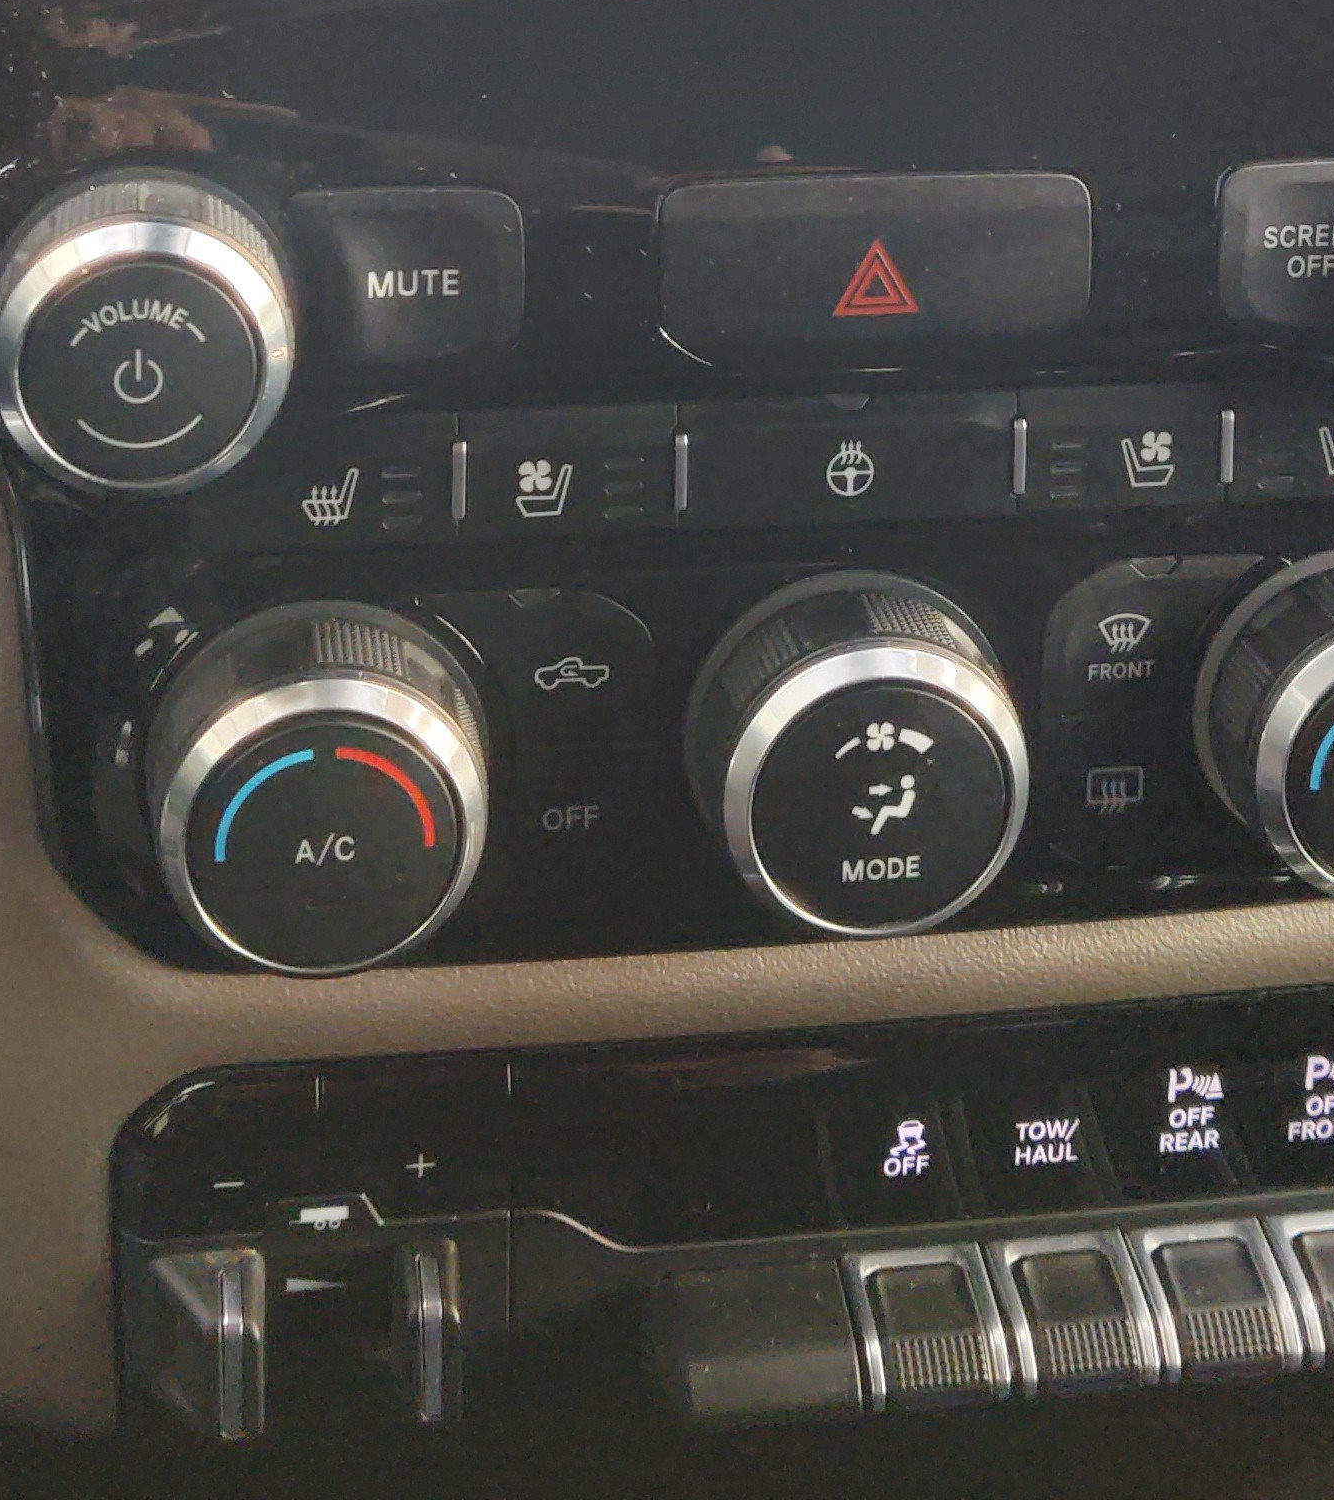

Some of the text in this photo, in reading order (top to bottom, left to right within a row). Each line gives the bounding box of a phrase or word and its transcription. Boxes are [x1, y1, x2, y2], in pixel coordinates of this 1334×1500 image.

[367, 270, 461, 299] MUTE
[81, 300, 189, 334] VOLUME
[1087, 660, 1155, 682] FRONT
[542, 805, 600, 832] OFF
[294, 835, 356, 867] A/C
[841, 855, 921, 883] MODE
[1016, 1117, 1080, 1144] TOW/
[1168, 1106, 1216, 1131] OFF
[1014, 1142, 1078, 1166] HAUL
[1159, 1129, 1220, 1154] REAR
[883, 1154, 930, 1178] OFF
